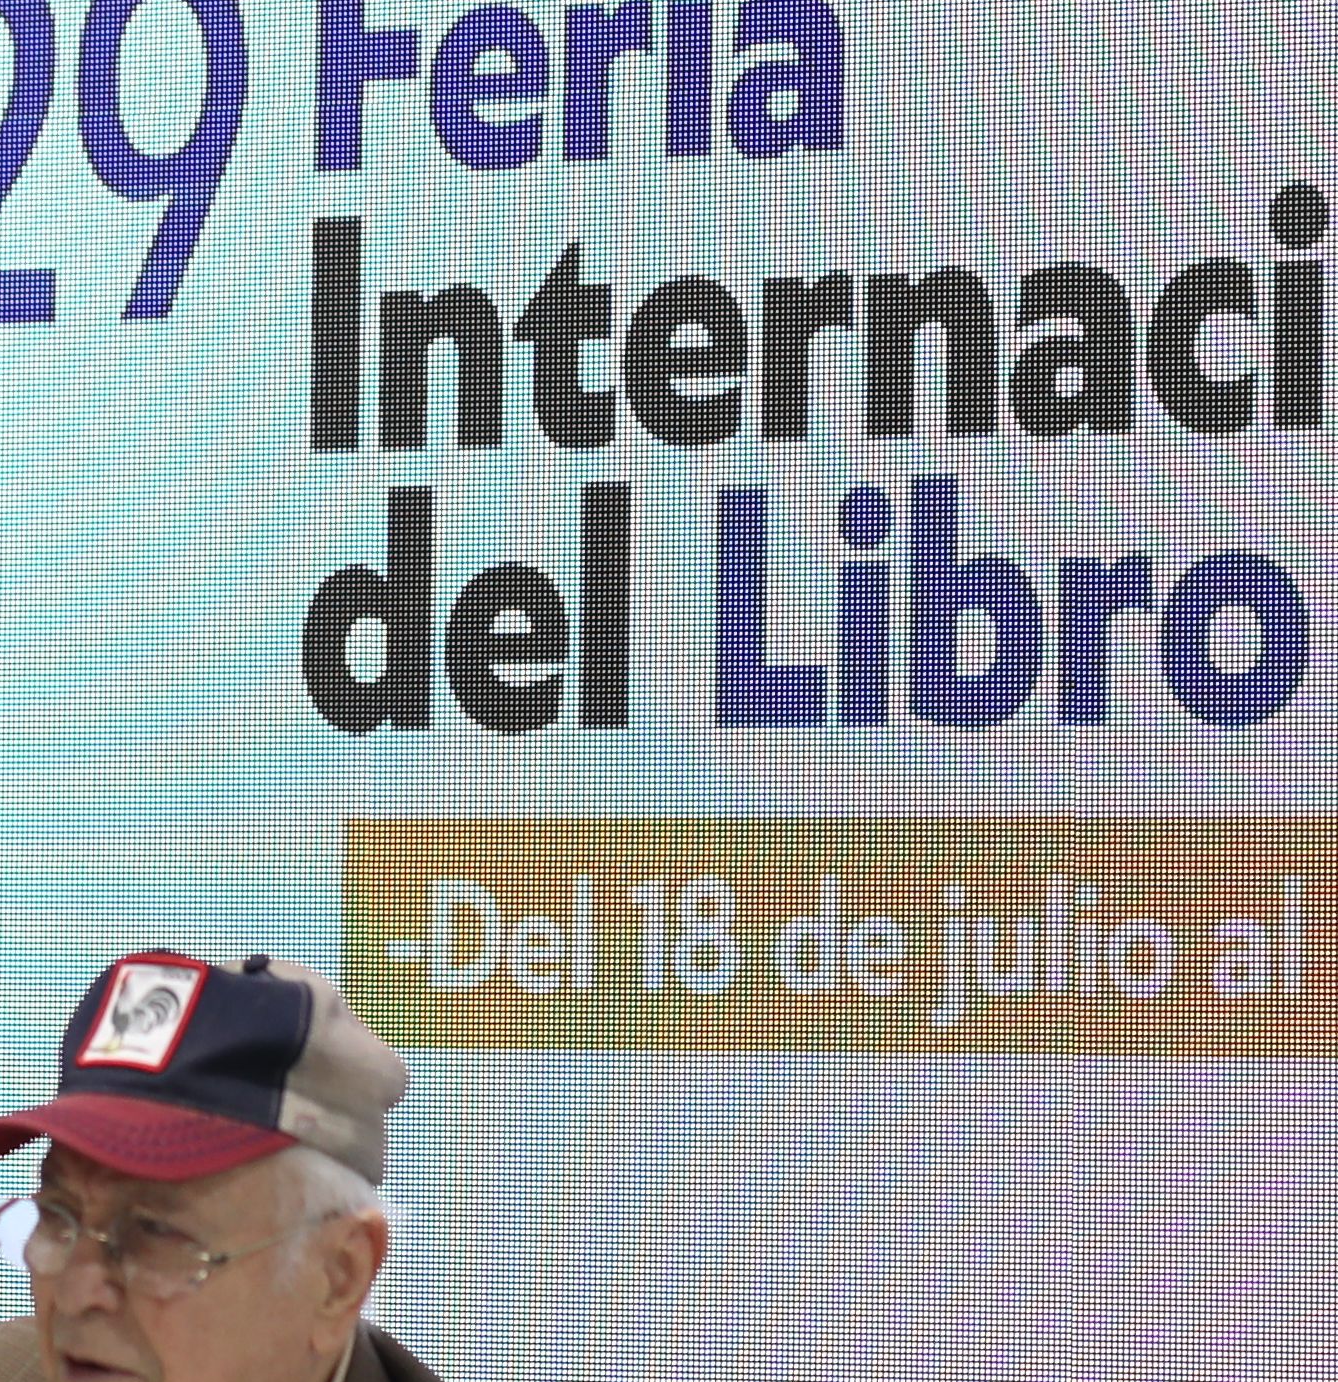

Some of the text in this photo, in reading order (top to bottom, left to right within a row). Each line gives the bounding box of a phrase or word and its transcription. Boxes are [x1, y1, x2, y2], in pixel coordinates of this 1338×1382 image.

[315, 0, 844, 170] Feria
[311, 180, 1324, 452] Internaci
[302, 474, 1309, 735] del Libro
[631, 874, 743, 994] 18
[770, 874, 907, 994] de
[928, 872, 1178, 1027] julio
[1211, 874, 1303, 997] al
